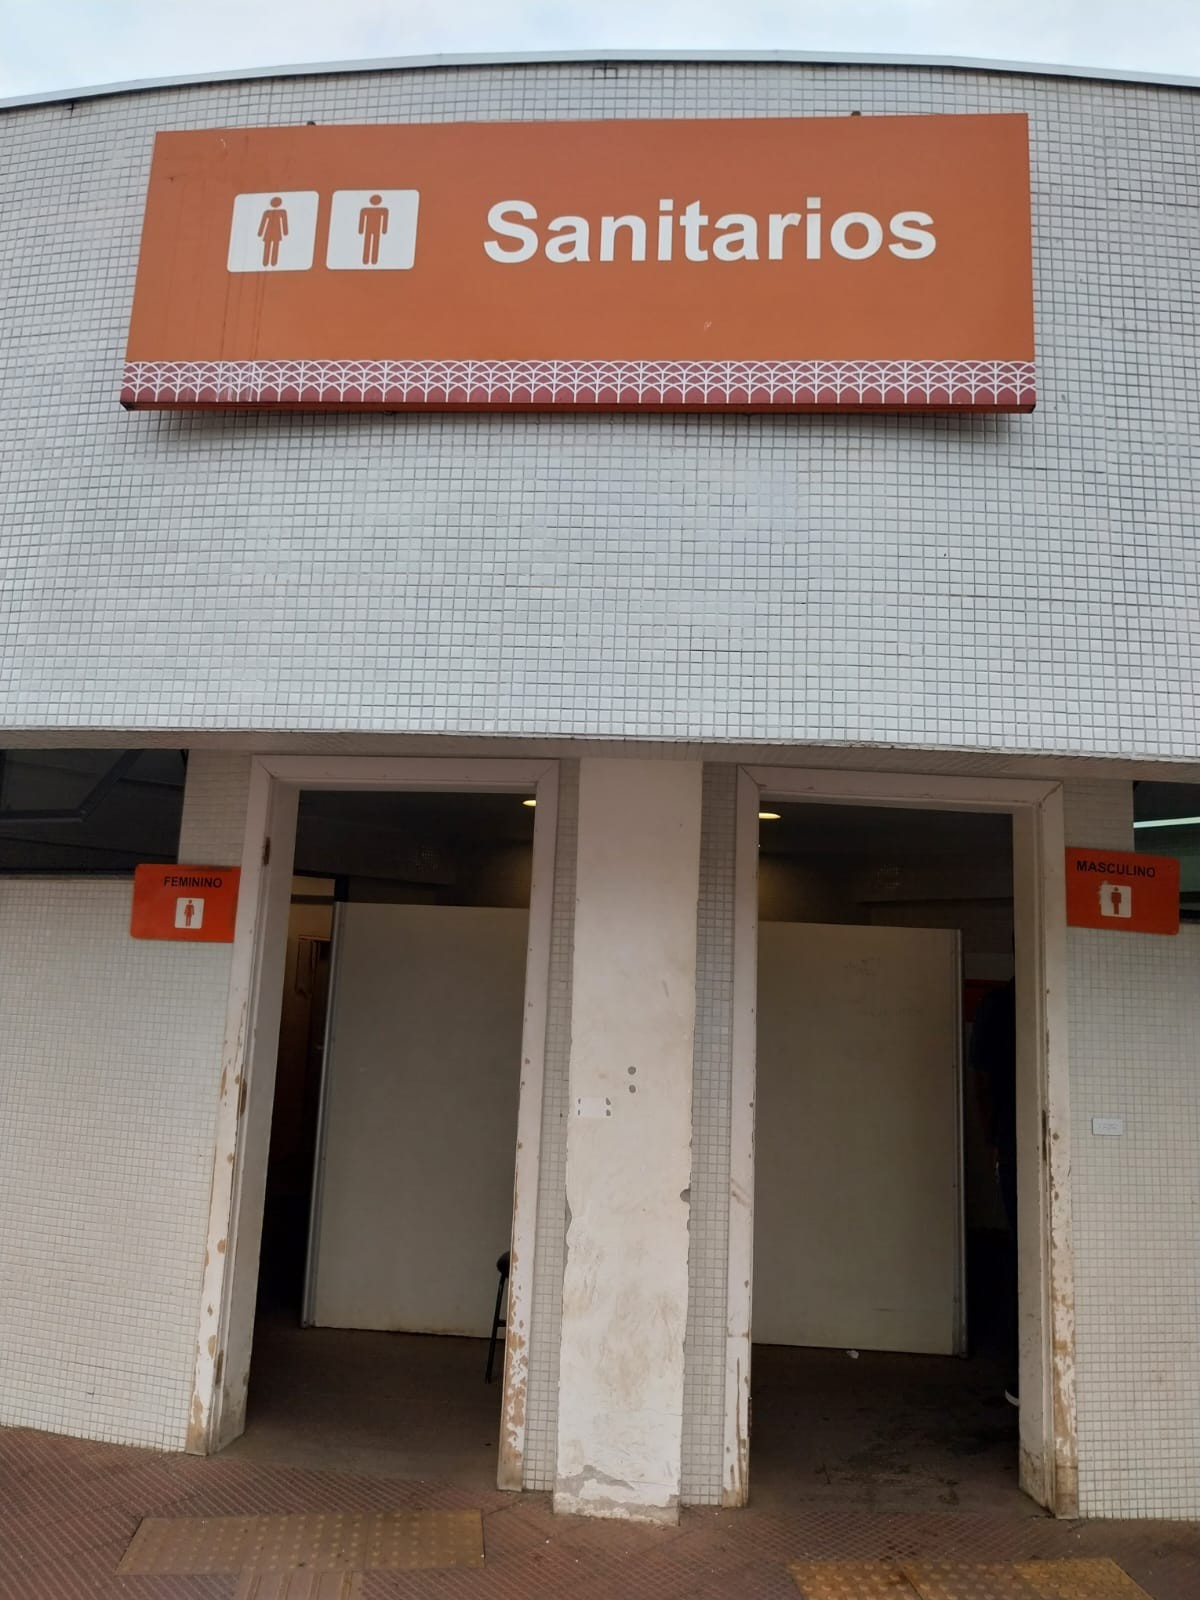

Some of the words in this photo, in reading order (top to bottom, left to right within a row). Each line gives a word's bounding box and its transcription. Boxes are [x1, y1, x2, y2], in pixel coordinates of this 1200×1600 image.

[483, 197, 936, 263] Sanitarios
[1076, 860, 1156, 878] MASCULINO
[163, 876, 223, 888] FEMININO
